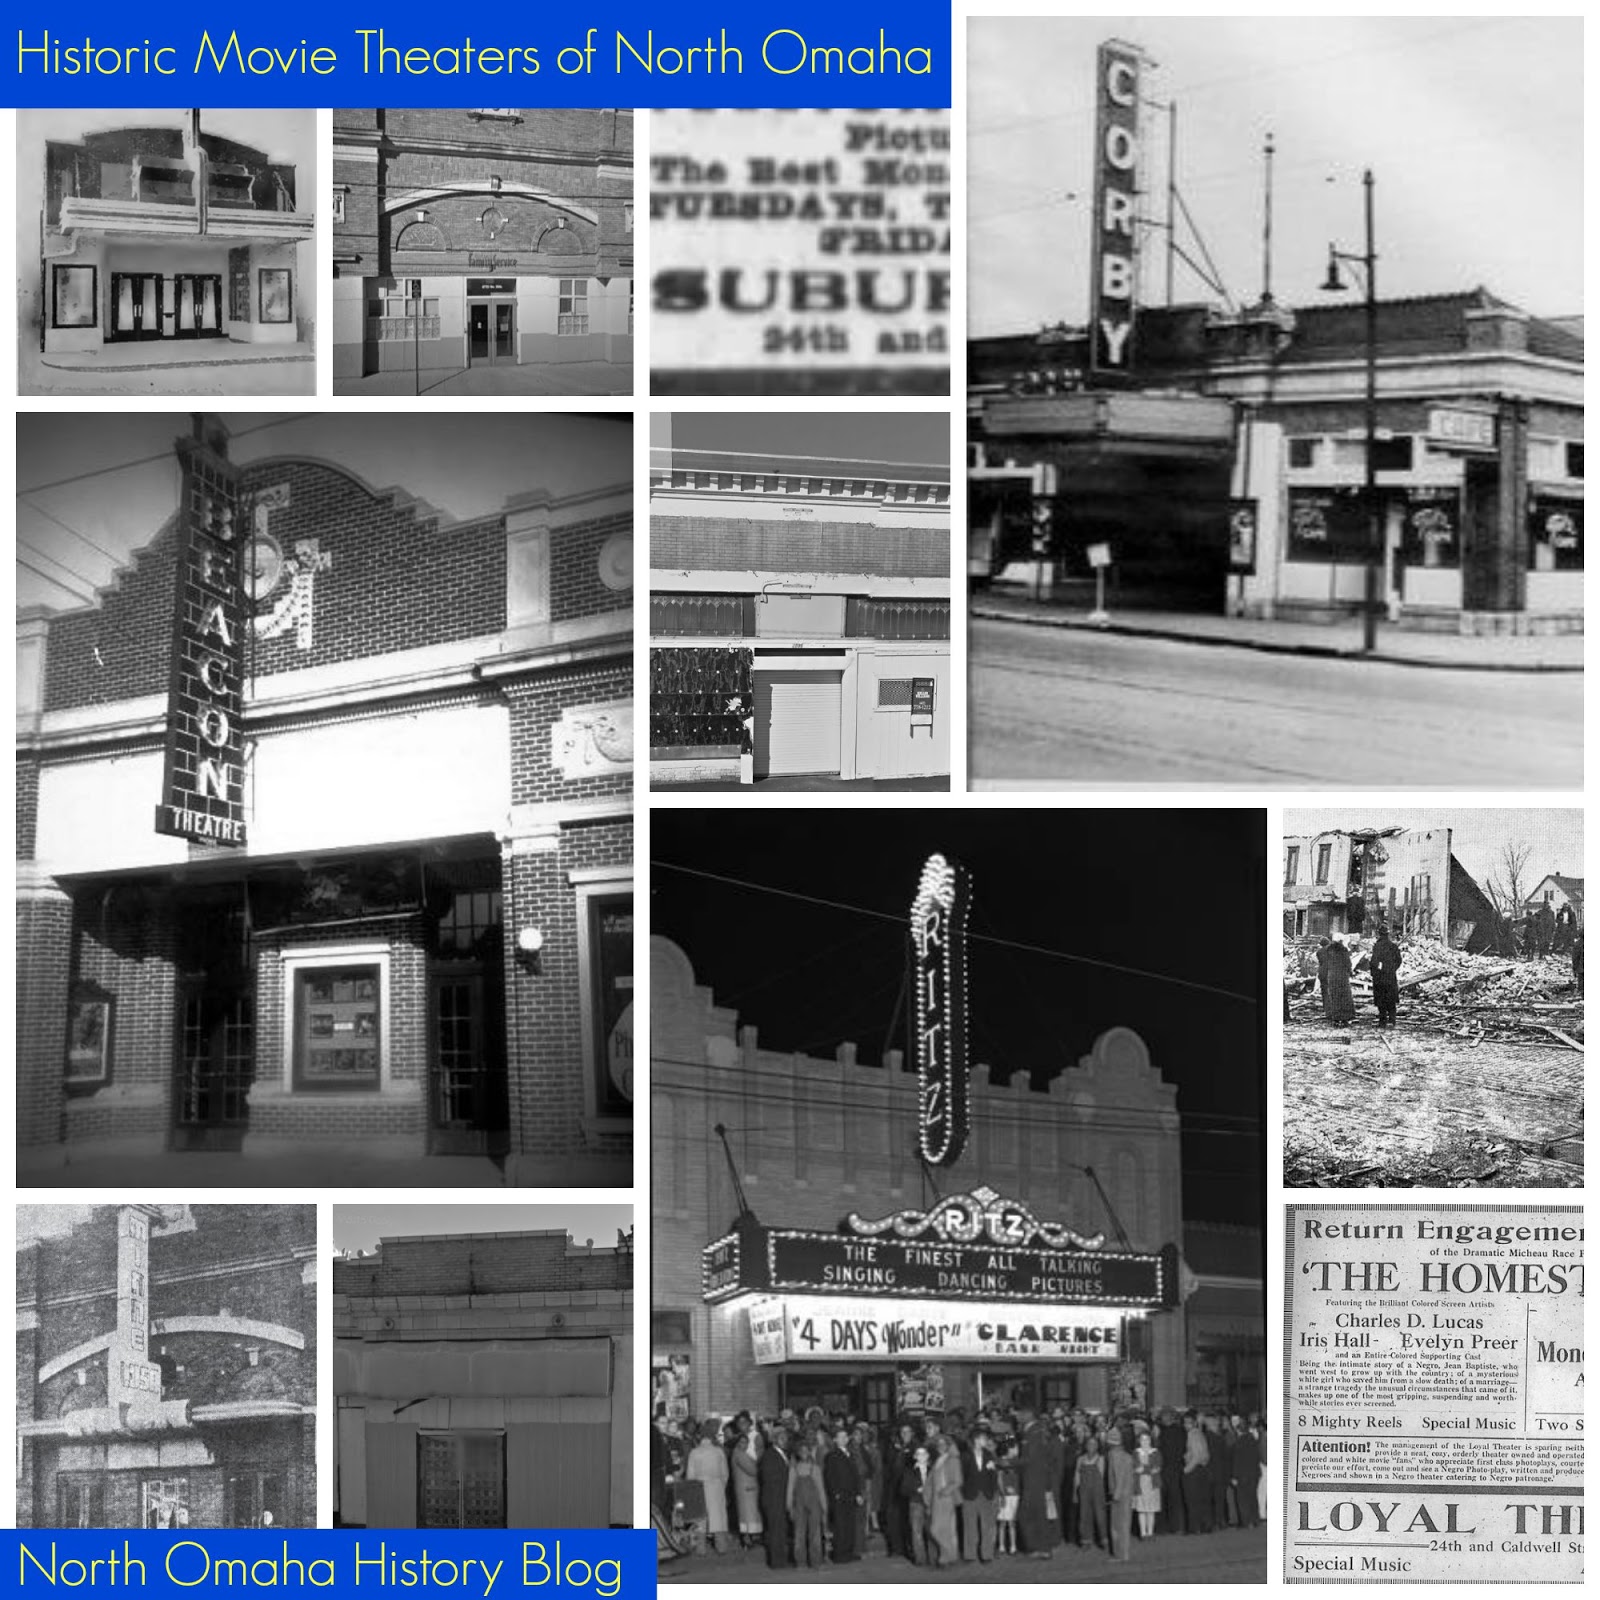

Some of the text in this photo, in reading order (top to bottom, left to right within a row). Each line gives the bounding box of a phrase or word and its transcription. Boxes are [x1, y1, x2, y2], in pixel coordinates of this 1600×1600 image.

[1101, 60, 1135, 364] CORBY
[763, 324, 948, 354] 24th and
[197, 500, 232, 801] BEACON
[173, 808, 244, 840] THEATRE
[922, 911, 943, 1125] RITZ
[945, 1209, 1025, 1238] RITZ
[1304, 1220, 1404, 1240] Return
[845, 1245, 1100, 1275] THE FINEST ALL TALKING
[1463, 1249, 1505, 1257] Dramatic
[1509, 1249, 1548, 1257] Micheau
[824, 1266, 1102, 1293] SINGING DANCING PICTURES
[1326, 1299, 1362, 1308] Featuring
[1336, 1313, 1484, 1329] Charles D. Lucas
[831, 1319, 877, 1350] DAYS
[978, 1324, 1117, 1344] CLARENCE
[1300, 1332, 1328, 1347] Iris
[1401, 1334, 1464, 1351] Evelyn
[1472, 1335, 1518, 1350] Preer
[1537, 1341, 1584, 1363] Mon
[1299, 1360, 1320, 1368] Being
[1374, 1361, 1392, 1369] story
[1304, 1384, 1332, 1392] strange
[1298, 1415, 1306, 1427] 8
[1312, 1415, 1361, 1430] Mighty
[1366, 1416, 1402, 1428] Reels
[1422, 1417, 1470, 1432] Special
[1475, 1418, 1516, 1430] Music
[1535, 1419, 1568, 1430] Two
[1302, 1441, 1370, 1452] Attention!
[1534, 1444, 1562, 1452] sparing
[1298, 1501, 1476, 1534] LOYAL
[1429, 1540, 1462, 1552] 24th
[1469, 1541, 1493, 1552] and
[1501, 1541, 1561, 1553] Caldwell
[1294, 1555, 1412, 1573] Special Music
